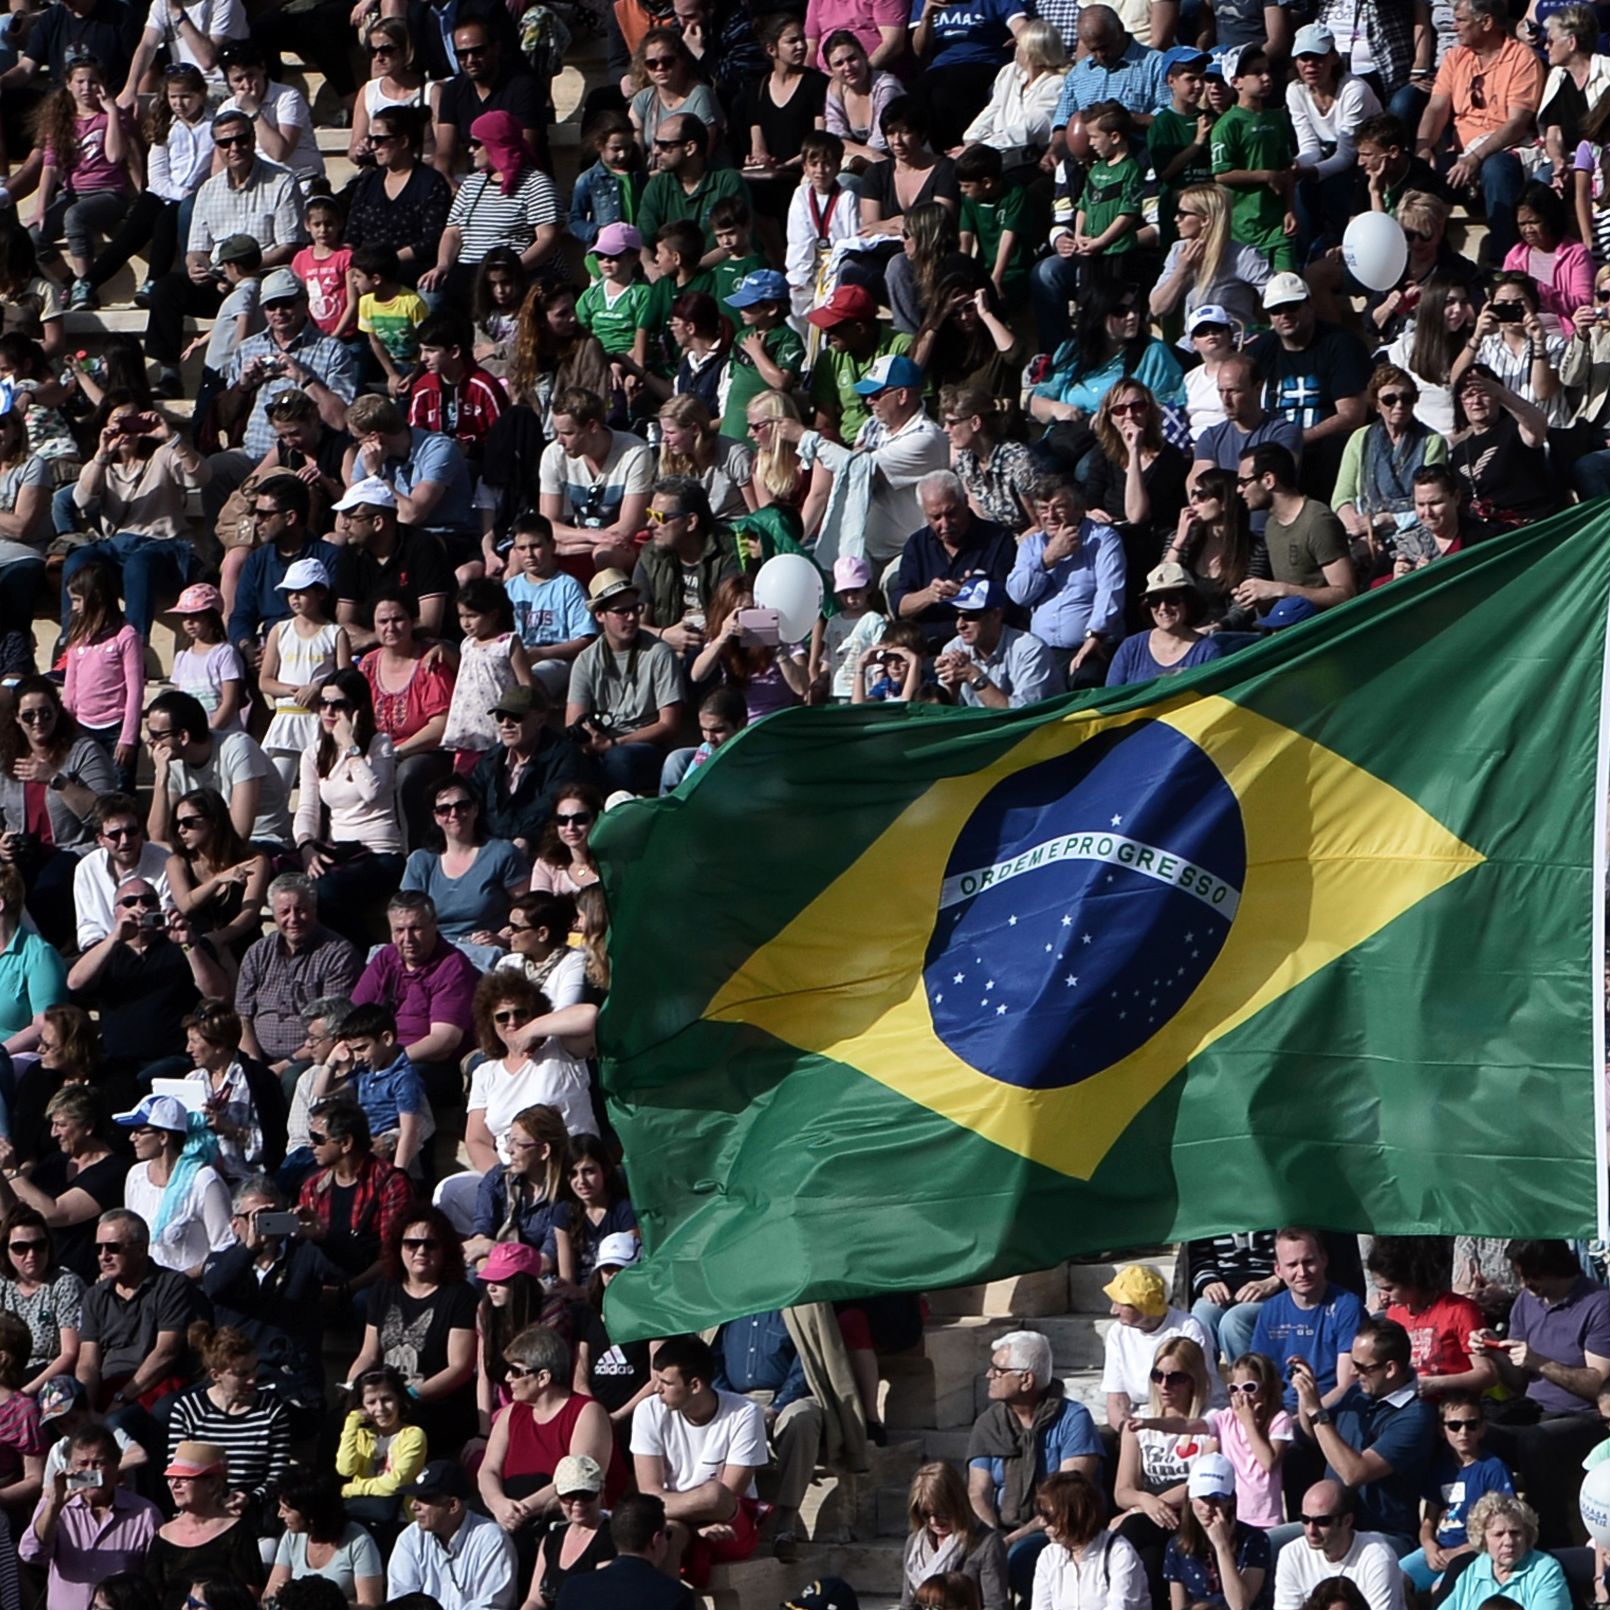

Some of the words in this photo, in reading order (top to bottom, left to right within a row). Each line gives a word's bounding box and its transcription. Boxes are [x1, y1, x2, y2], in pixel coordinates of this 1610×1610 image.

[960, 848, 1044, 895] ORDEM
[1048, 841, 1061, 859] E
[1063, 836, 1228, 905] PROGRESSO
[594, 1364, 636, 1376] adidas
